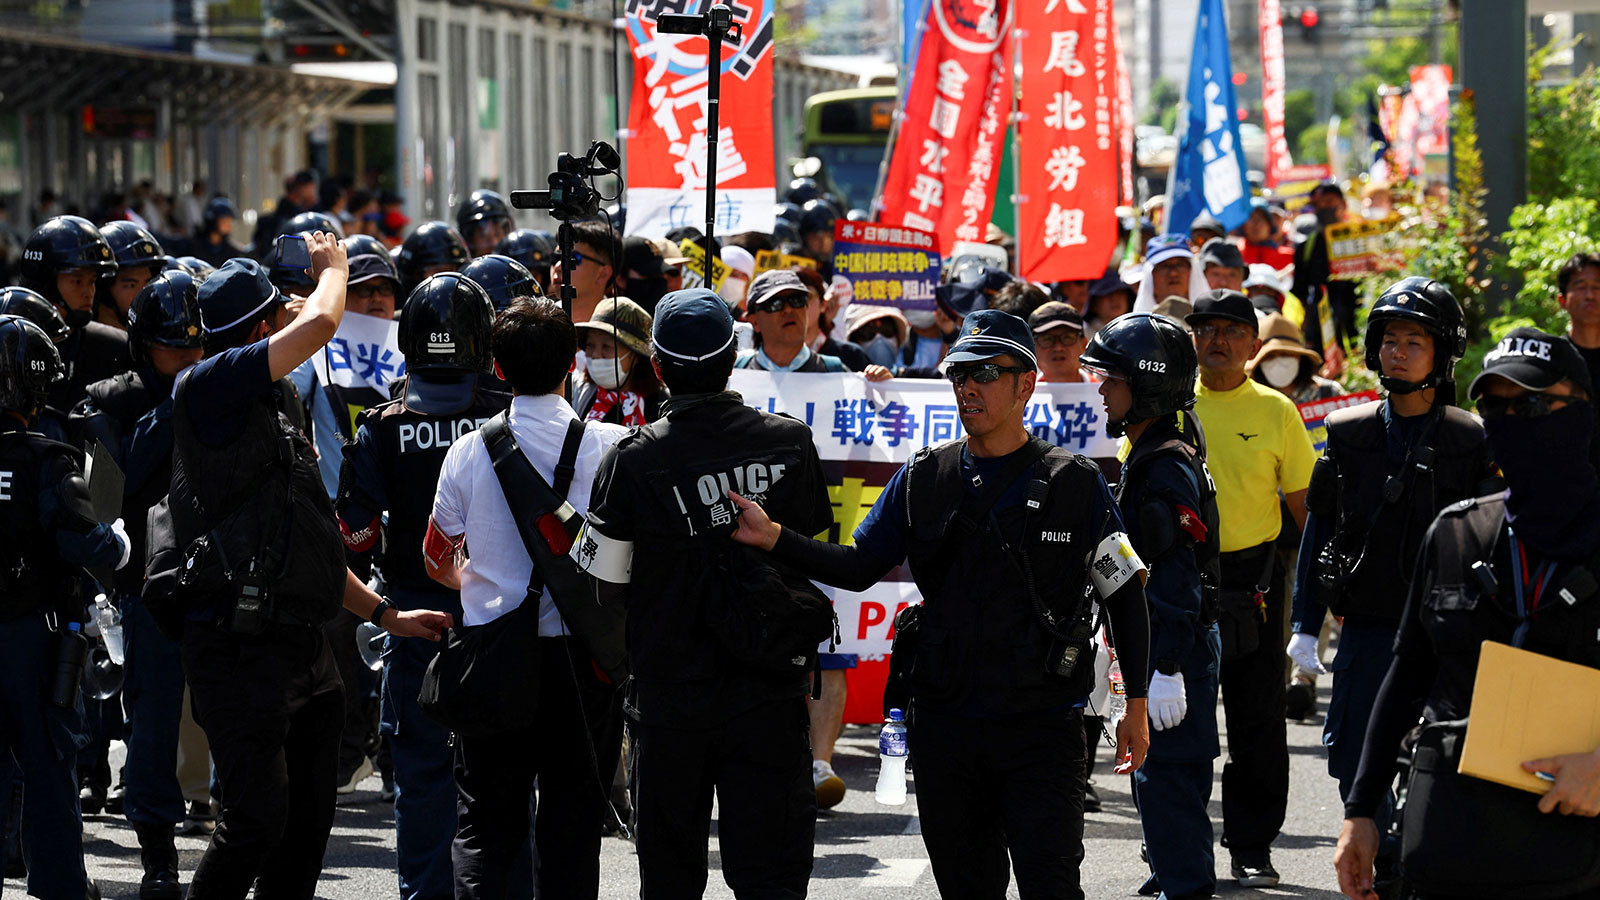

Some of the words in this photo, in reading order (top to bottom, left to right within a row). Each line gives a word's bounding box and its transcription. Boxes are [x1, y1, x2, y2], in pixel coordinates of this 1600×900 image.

[24, 249, 43, 261] 6133
[853, 279, 941, 301] 核戦争阻止
[430, 332, 450, 343] 613
[31, 360, 45, 371] 613
[328, 337, 406, 386] 日米
[1138, 358, 1167, 374] 6132
[1041, 531, 1071, 542] POLICE
